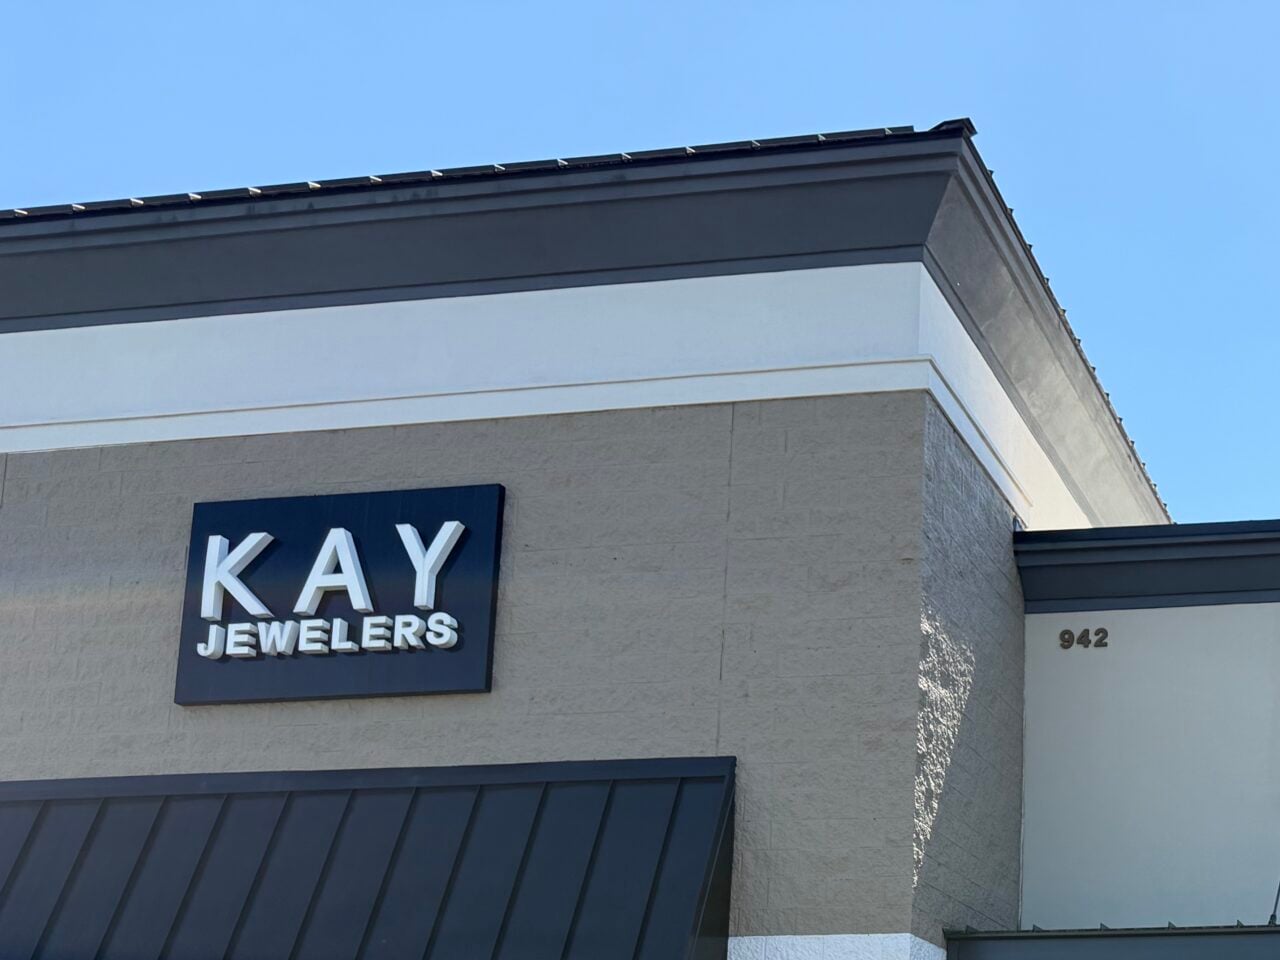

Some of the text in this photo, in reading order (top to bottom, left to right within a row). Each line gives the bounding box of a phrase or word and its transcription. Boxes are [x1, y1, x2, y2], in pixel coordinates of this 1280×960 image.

[201, 520, 466, 621] KAY
[197, 612, 459, 660] JEWELERS
[1059, 628, 1108, 649] 942
